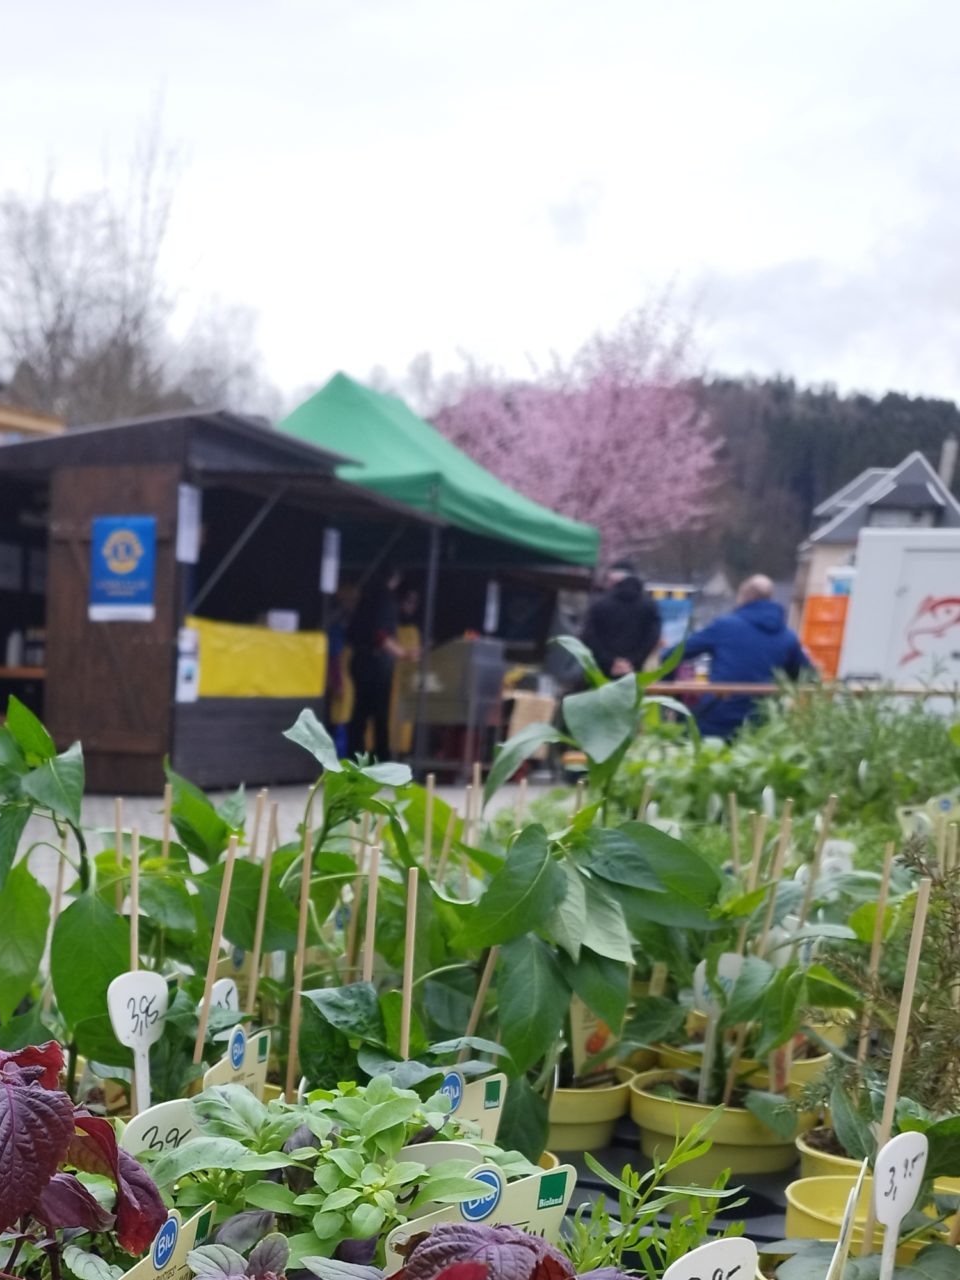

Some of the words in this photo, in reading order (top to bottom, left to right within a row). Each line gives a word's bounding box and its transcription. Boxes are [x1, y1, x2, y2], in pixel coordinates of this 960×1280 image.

[127, 995, 159, 1036] 3,95
[539, 1194, 563, 1208] Bioland
[158, 1232, 174, 1258] Blu
